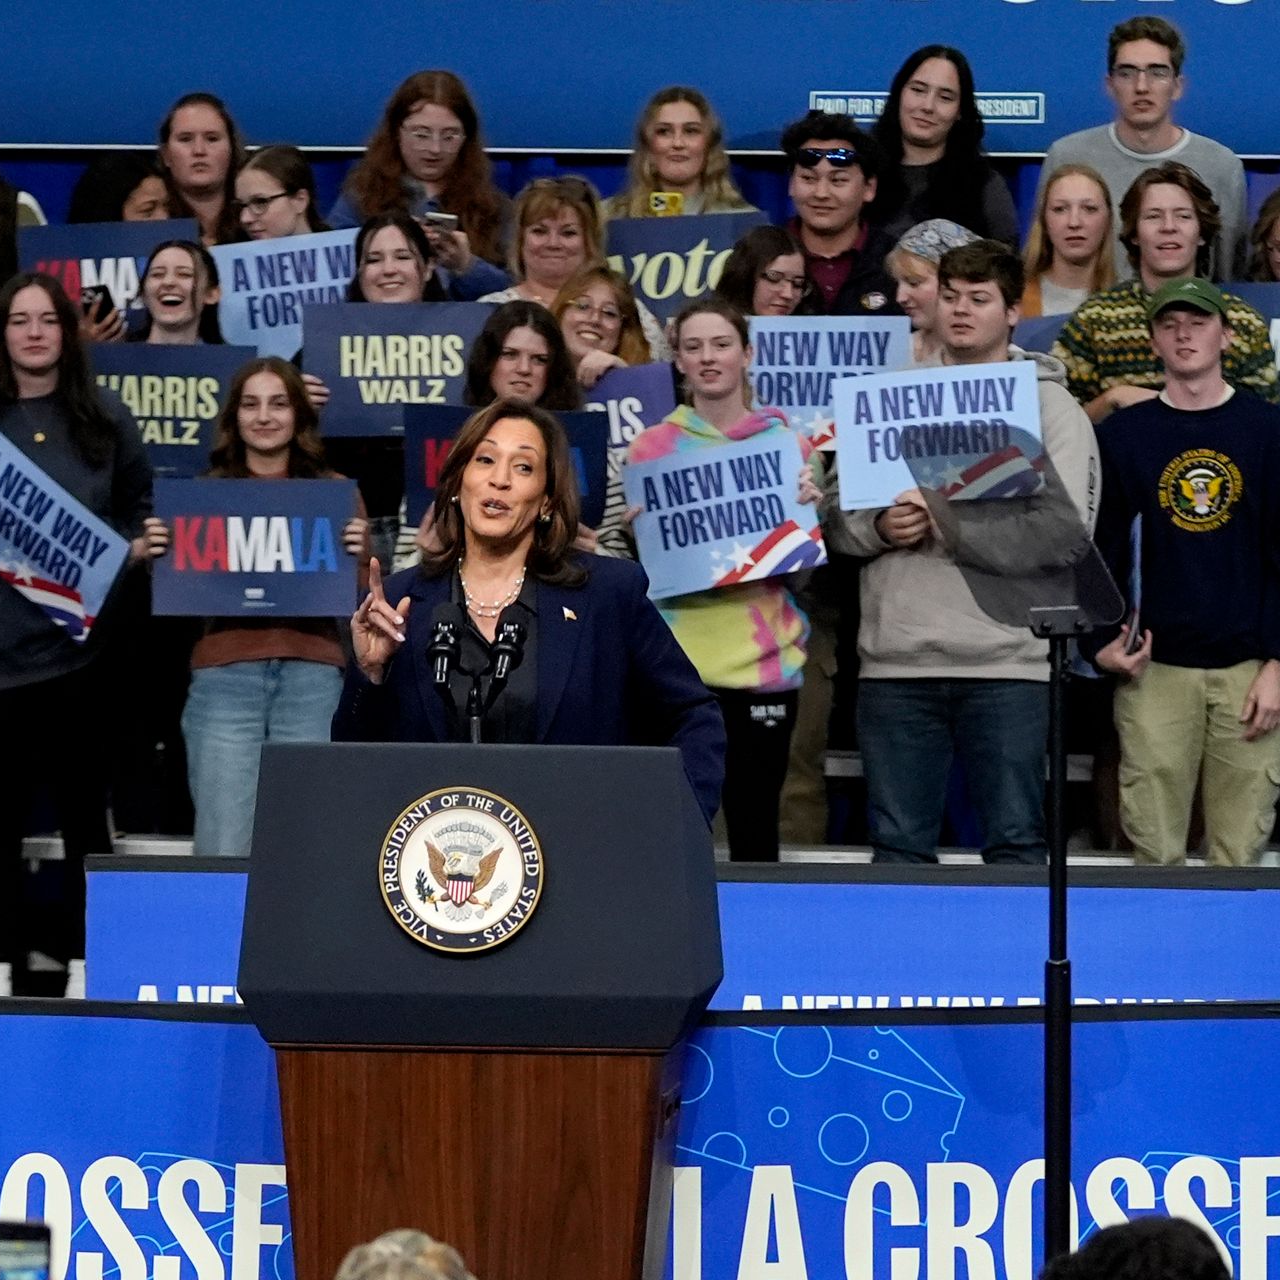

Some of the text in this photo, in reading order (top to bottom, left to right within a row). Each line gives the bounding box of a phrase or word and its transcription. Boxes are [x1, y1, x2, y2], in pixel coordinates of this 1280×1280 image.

[976, 98, 1038, 116] RESIDENT
[233, 258, 251, 292] A
[256, 247, 318, 289] NEW
[340, 334, 464, 378] HARRIS
[757, 331, 891, 367] NEW WAY
[358, 379, 446, 404] WALZ
[854, 377, 1016, 425] A NEW WAY
[137, 421, 200, 446] ALZ
[868, 418, 1010, 463] FORWARD
[643, 450, 783, 512] A NEW WAY
[50, 507, 109, 567] WAY
[174, 515, 338, 573] KAMALA
[658, 493, 785, 551] FORWARD
[384, 794, 540, 943] VICE PRESIDENT OF THE UNITED STATES
